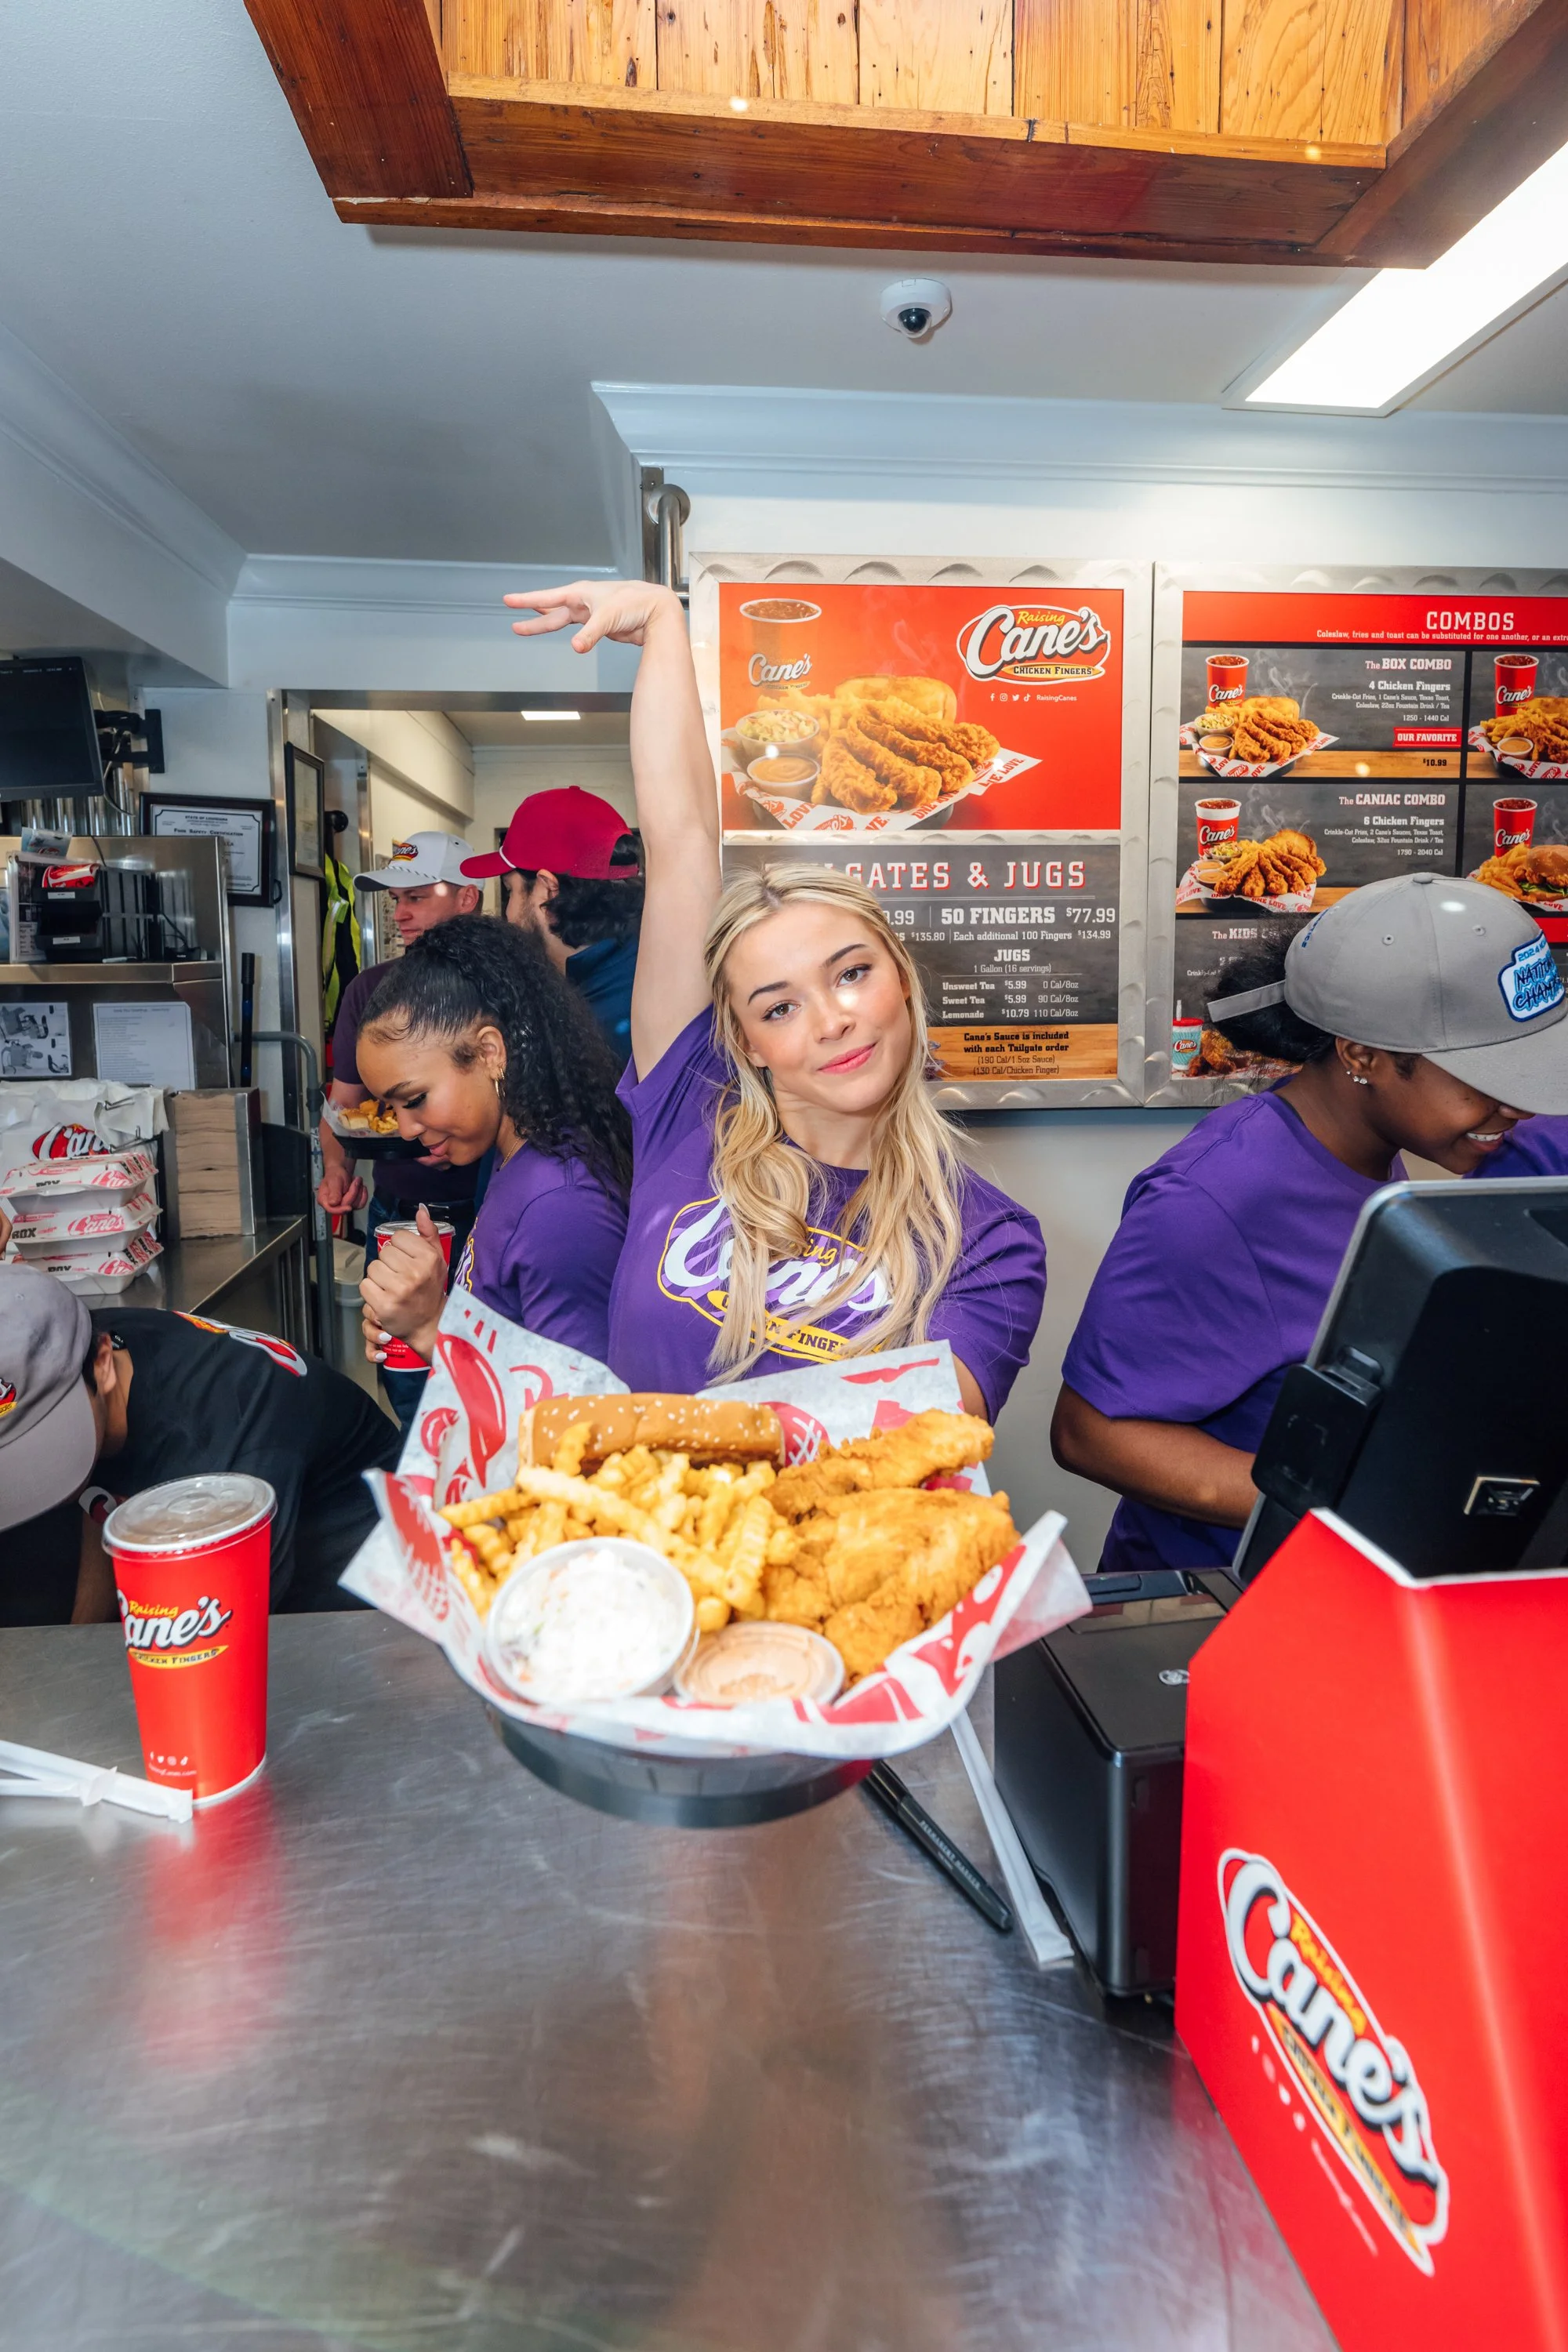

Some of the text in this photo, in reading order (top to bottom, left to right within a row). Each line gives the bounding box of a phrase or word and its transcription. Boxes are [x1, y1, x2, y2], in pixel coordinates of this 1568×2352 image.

[1017, 611, 1065, 626] Raising
[1426, 612, 1514, 630] COMBOS
[1316, 630, 1350, 639] Coleslaw,
[966, 606, 1107, 678] Cane's
[748, 652, 812, 687] Cane's
[1365, 658, 1452, 670] The BOX COMBO
[1054, 666, 1092, 675] FINGERS
[1208, 684, 1243, 702] Cane's
[1369, 681, 1450, 693] 4 Chicken Fingers
[1496, 685, 1532, 704] Cane's
[1397, 733, 1457, 742] OUR FAVORITE
[1422, 758, 1447, 767] $10.99
[1356, 793, 1400, 805] CANIAC
[1404, 794, 1446, 805] COMBO
[1372, 816, 1408, 825] Chicken
[1410, 817, 1444, 826] Fingers
[1199, 825, 1235, 845] Cane's
[1495, 828, 1530, 847] Cane's
[967, 862, 990, 890] &
[1004, 861, 1085, 890] JUGS
[941, 906, 1116, 924] 50 FINGERS $77.99
[911, 932, 946, 941] $135.80
[953, 929, 1111, 941] Each additional 100 Fingers $134.99
[1212, 931, 1228, 939] The
[1229, 927, 1258, 939] KIDS
[993, 949, 1030, 961] JUGS
[1518, 945, 1540, 961] 2024
[980, 964, 1003, 973] Gallon
[1004, 964, 1018, 974] (16
[1018, 964, 1051, 974] servings)
[942, 982, 978, 990] Unsweet
[1004, 980, 1027, 989] $5.99
[1043, 981, 1048, 989] 0
[1050, 980, 1079, 989] Cal/8oz
[942, 994, 1079, 1005] Sweet Tea $5.99 90 Cal/8oz
[942, 1008, 1079, 1019] Lemonade $10.79 110 Cal/8oz
[964, 1033, 991, 1041] Cane's
[993, 1032, 1019, 1040] Sauce
[1032, 1031, 1069, 1040] included
[964, 1044, 982, 1053] with
[1007, 1044, 1043, 1054] Tailgate
[1174, 1040, 1196, 1052] Cane's
[978, 1055, 994, 1065] (190
[1032, 1054, 1055, 1063] Sauce)
[973, 1065, 1059, 1076] (130 Cal/Chicken Finger)
[12, 1228, 37, 1239] BOX
[129, 1600, 180, 1618] Raising
[172, 1648, 220, 1664] FINGERS
[1228, 1859, 1439, 2189] Cane's
